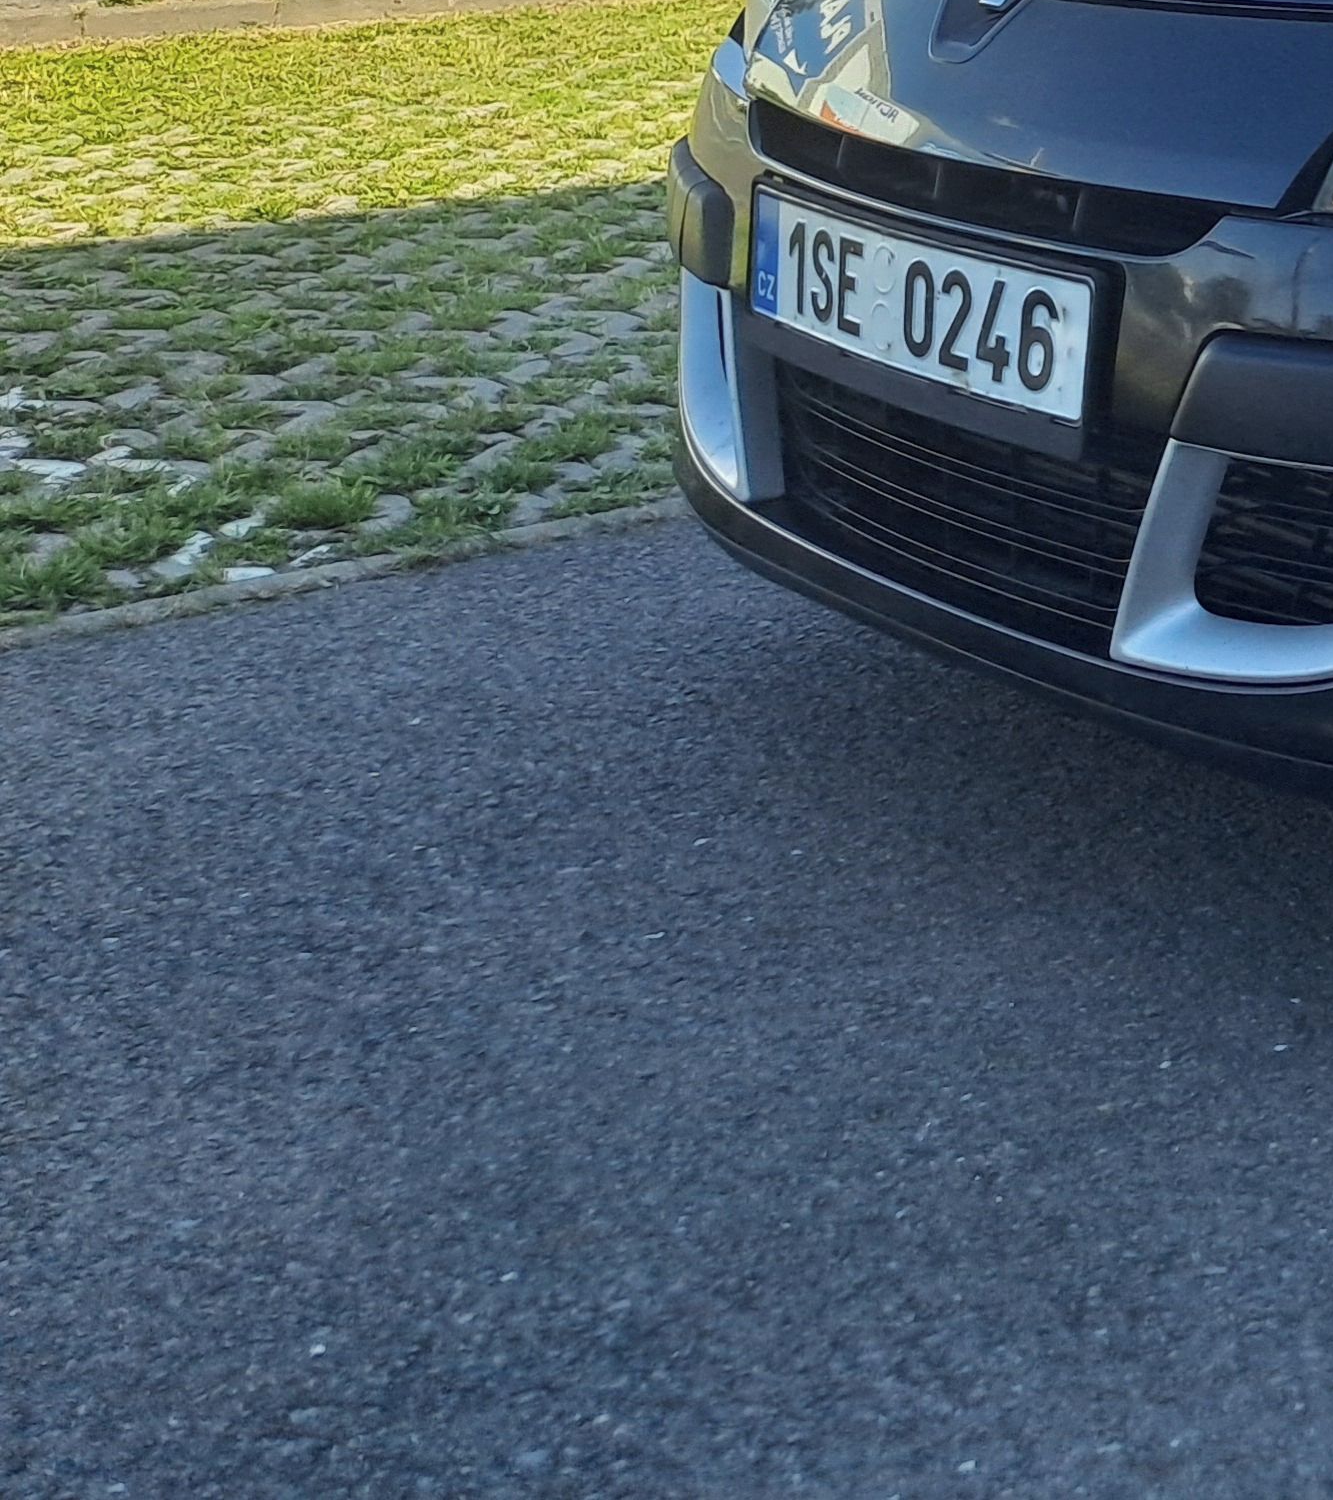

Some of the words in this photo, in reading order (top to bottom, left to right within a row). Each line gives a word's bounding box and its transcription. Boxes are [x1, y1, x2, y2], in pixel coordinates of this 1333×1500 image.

[758, 270, 775, 300] CZ
[789, 219, 865, 337] 1SE
[904, 260, 1059, 391] 0246
